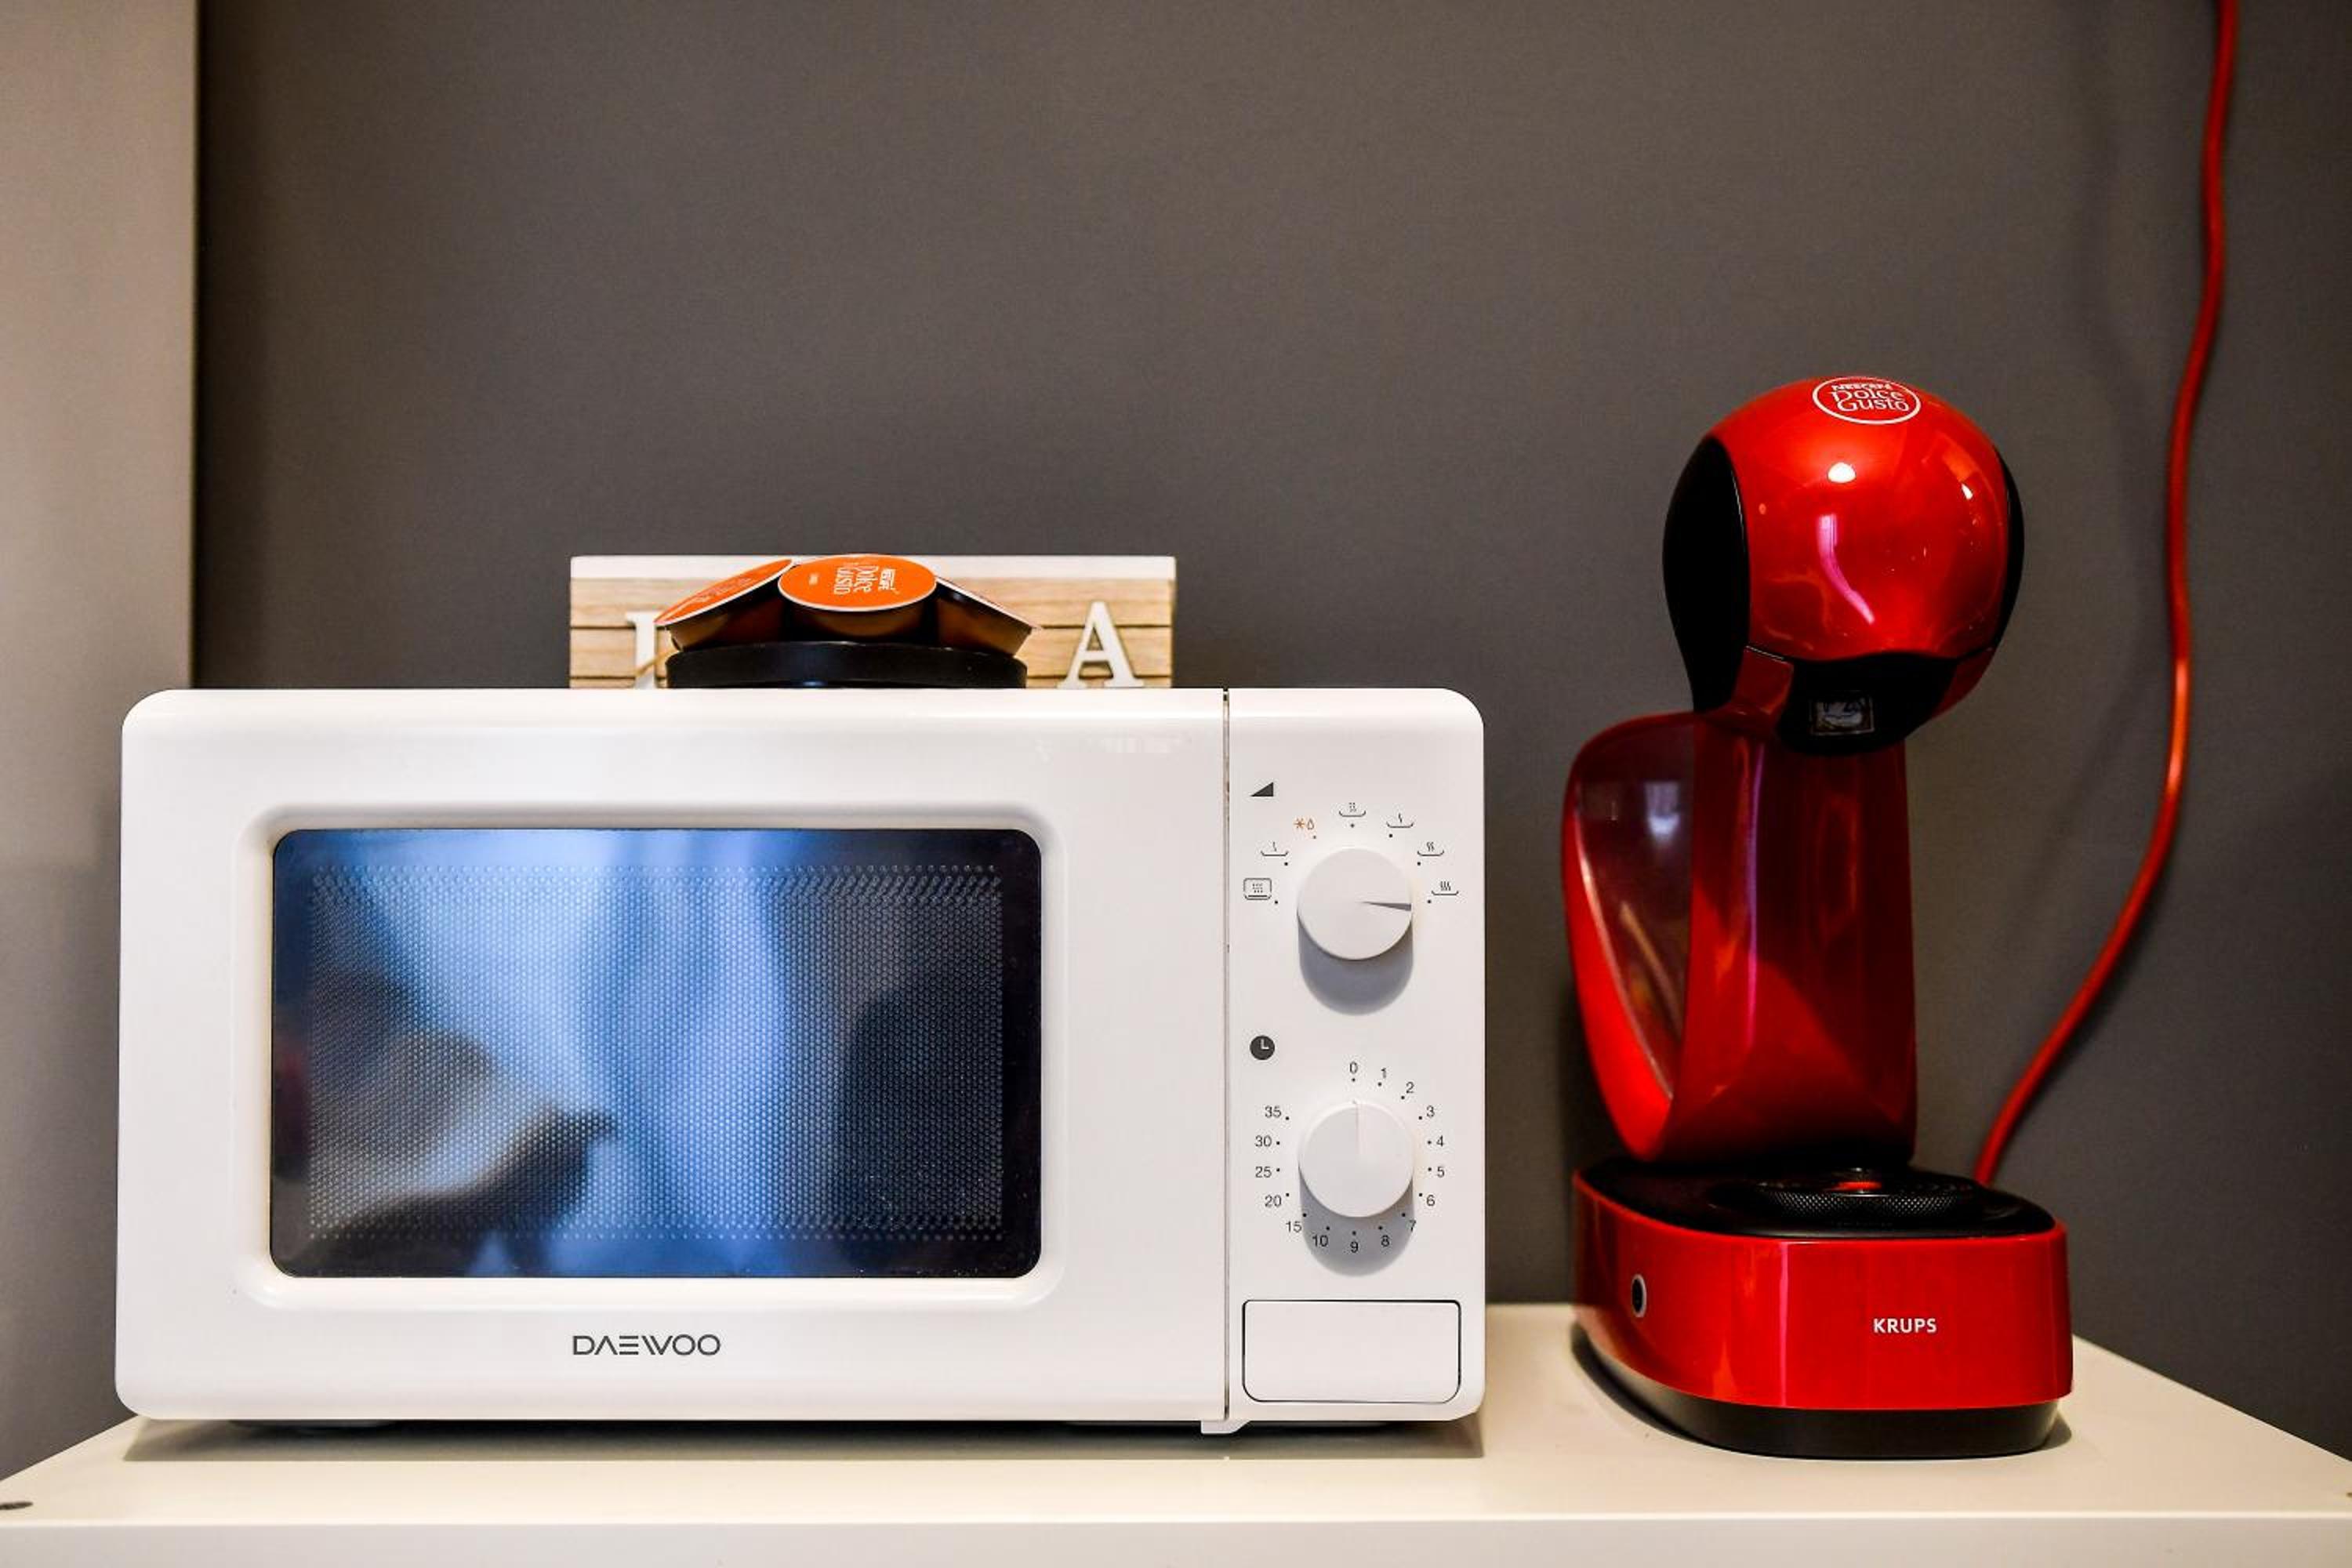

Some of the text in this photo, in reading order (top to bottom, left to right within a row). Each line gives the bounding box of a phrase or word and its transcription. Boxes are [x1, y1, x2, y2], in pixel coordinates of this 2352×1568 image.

[1831, 387, 1906, 402] Dolce
[1837, 398, 1909, 412] Gusto
[1055, 600, 1145, 689] A
[1349, 1062, 1359, 1074] 0
[1381, 1068, 1388, 1079] 1
[1406, 1082, 1415, 1094] 2
[1265, 1106, 1282, 1118] 35
[1426, 1106, 1436, 1118] 3
[1254, 1136, 1272, 1148] 30
[1436, 1136, 1444, 1147] 4
[1255, 1167, 1272, 1178] 25
[1437, 1167, 1445, 1178] 5
[1265, 1196, 1282, 1207] 20
[1426, 1196, 1436, 1207] 6
[1286, 1221, 1302, 1233] 15
[1409, 1220, 1417, 1232] 7
[1312, 1235, 1329, 1247] 10
[1350, 1241, 1359, 1253] 9
[1381, 1236, 1390, 1247] 8
[1873, 1318, 1937, 1334] KRUPS
[572, 1334, 721, 1356] DAEWOO
